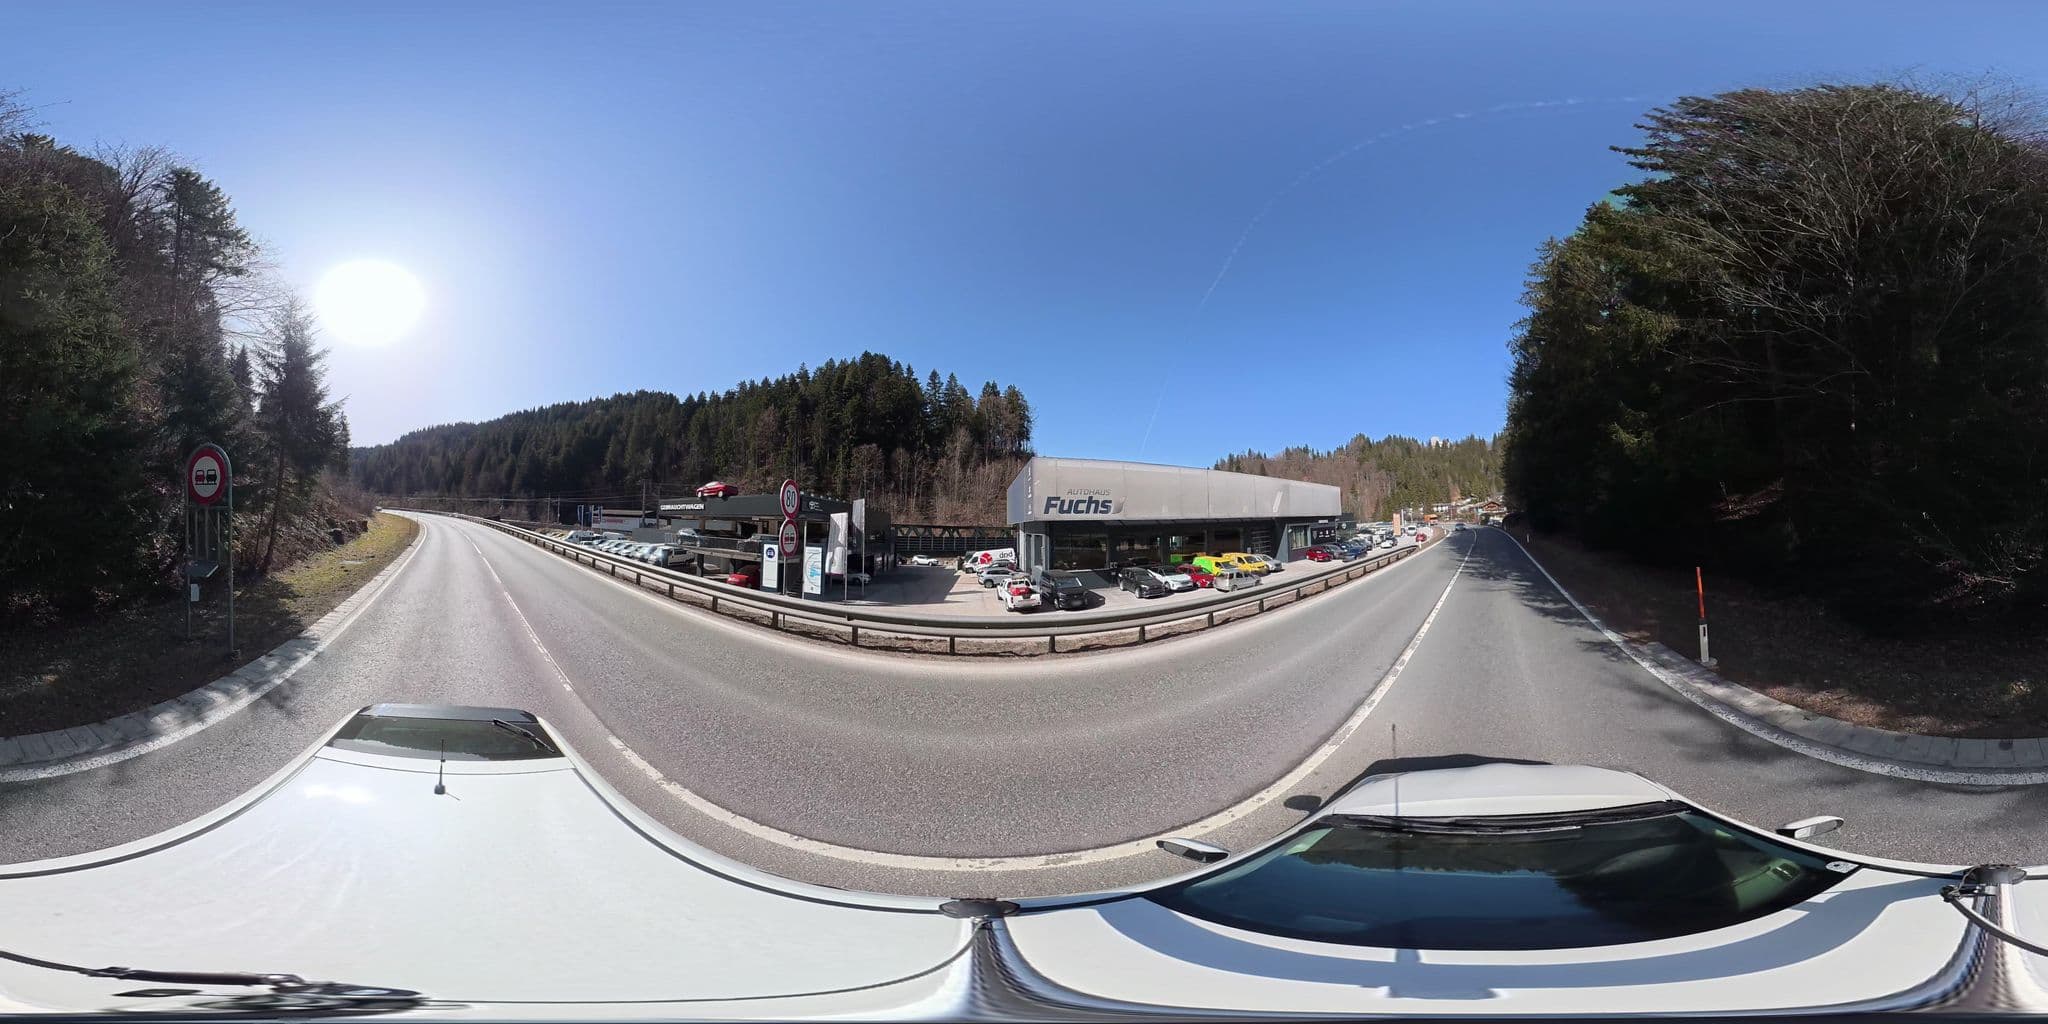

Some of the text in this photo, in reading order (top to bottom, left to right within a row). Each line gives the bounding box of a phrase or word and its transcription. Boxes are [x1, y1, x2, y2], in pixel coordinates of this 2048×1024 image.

[786, 490, 795, 508] 80
[1066, 488, 1112, 496] AUTOHAUS
[1043, 496, 1113, 514] Fuchs
